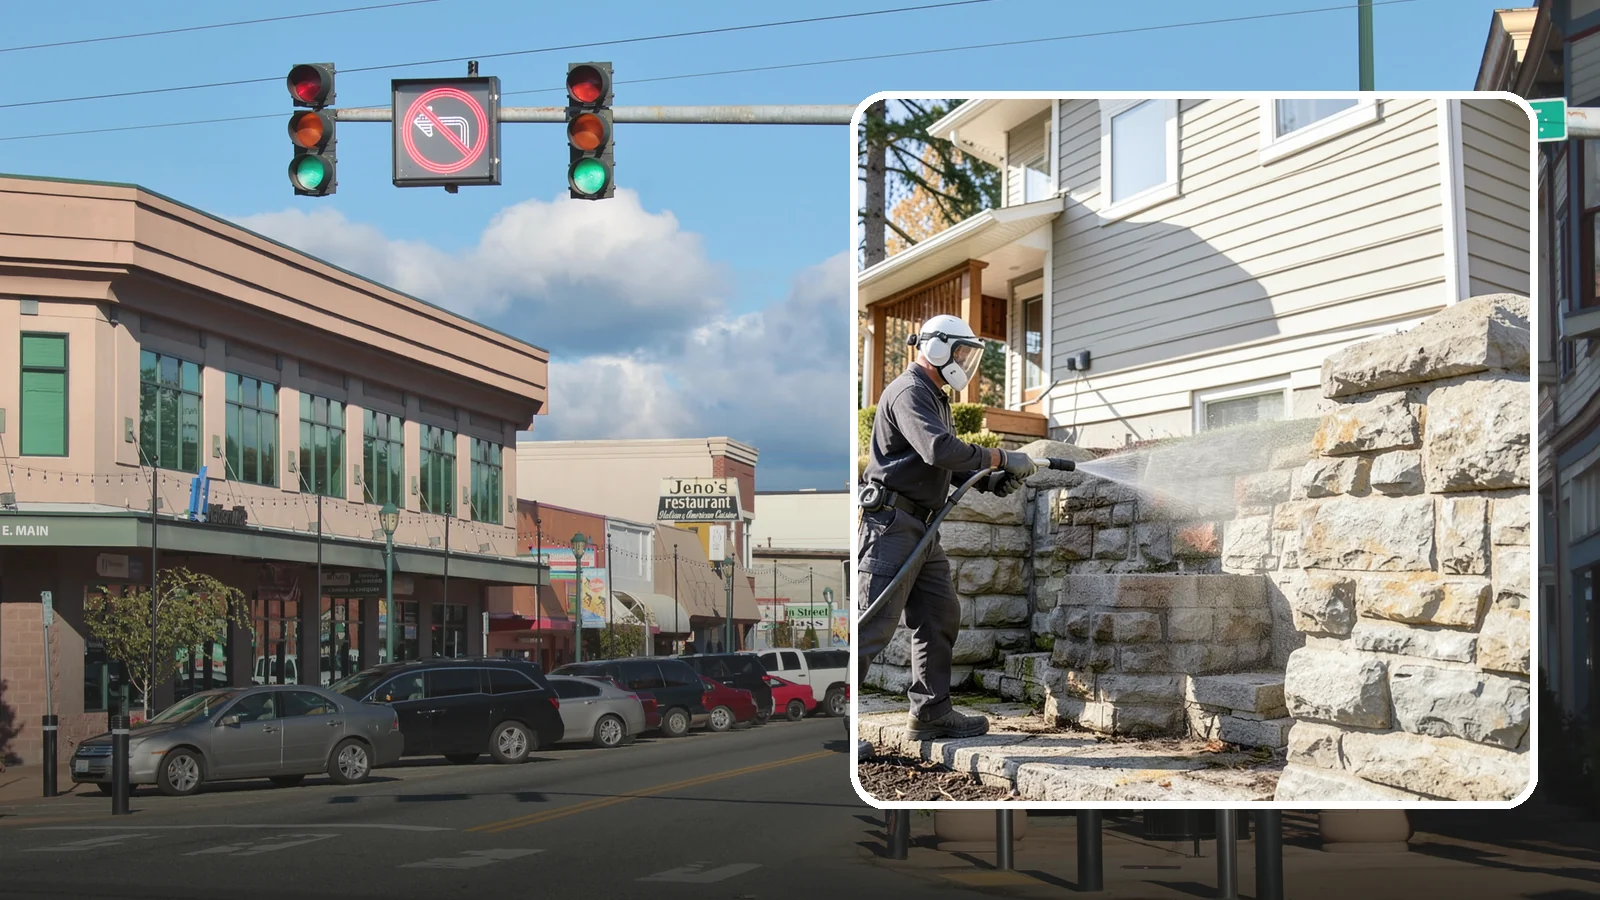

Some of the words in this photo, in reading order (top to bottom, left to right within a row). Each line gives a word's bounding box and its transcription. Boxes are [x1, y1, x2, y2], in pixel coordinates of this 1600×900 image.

[670, 480, 728, 494] Jeno's
[666, 497, 731, 508] restaurant
[2, 525, 13, 536] E.
[15, 525, 49, 536] MAIN
[797, 608, 828, 616] Street
[791, 619, 823, 627] lass
